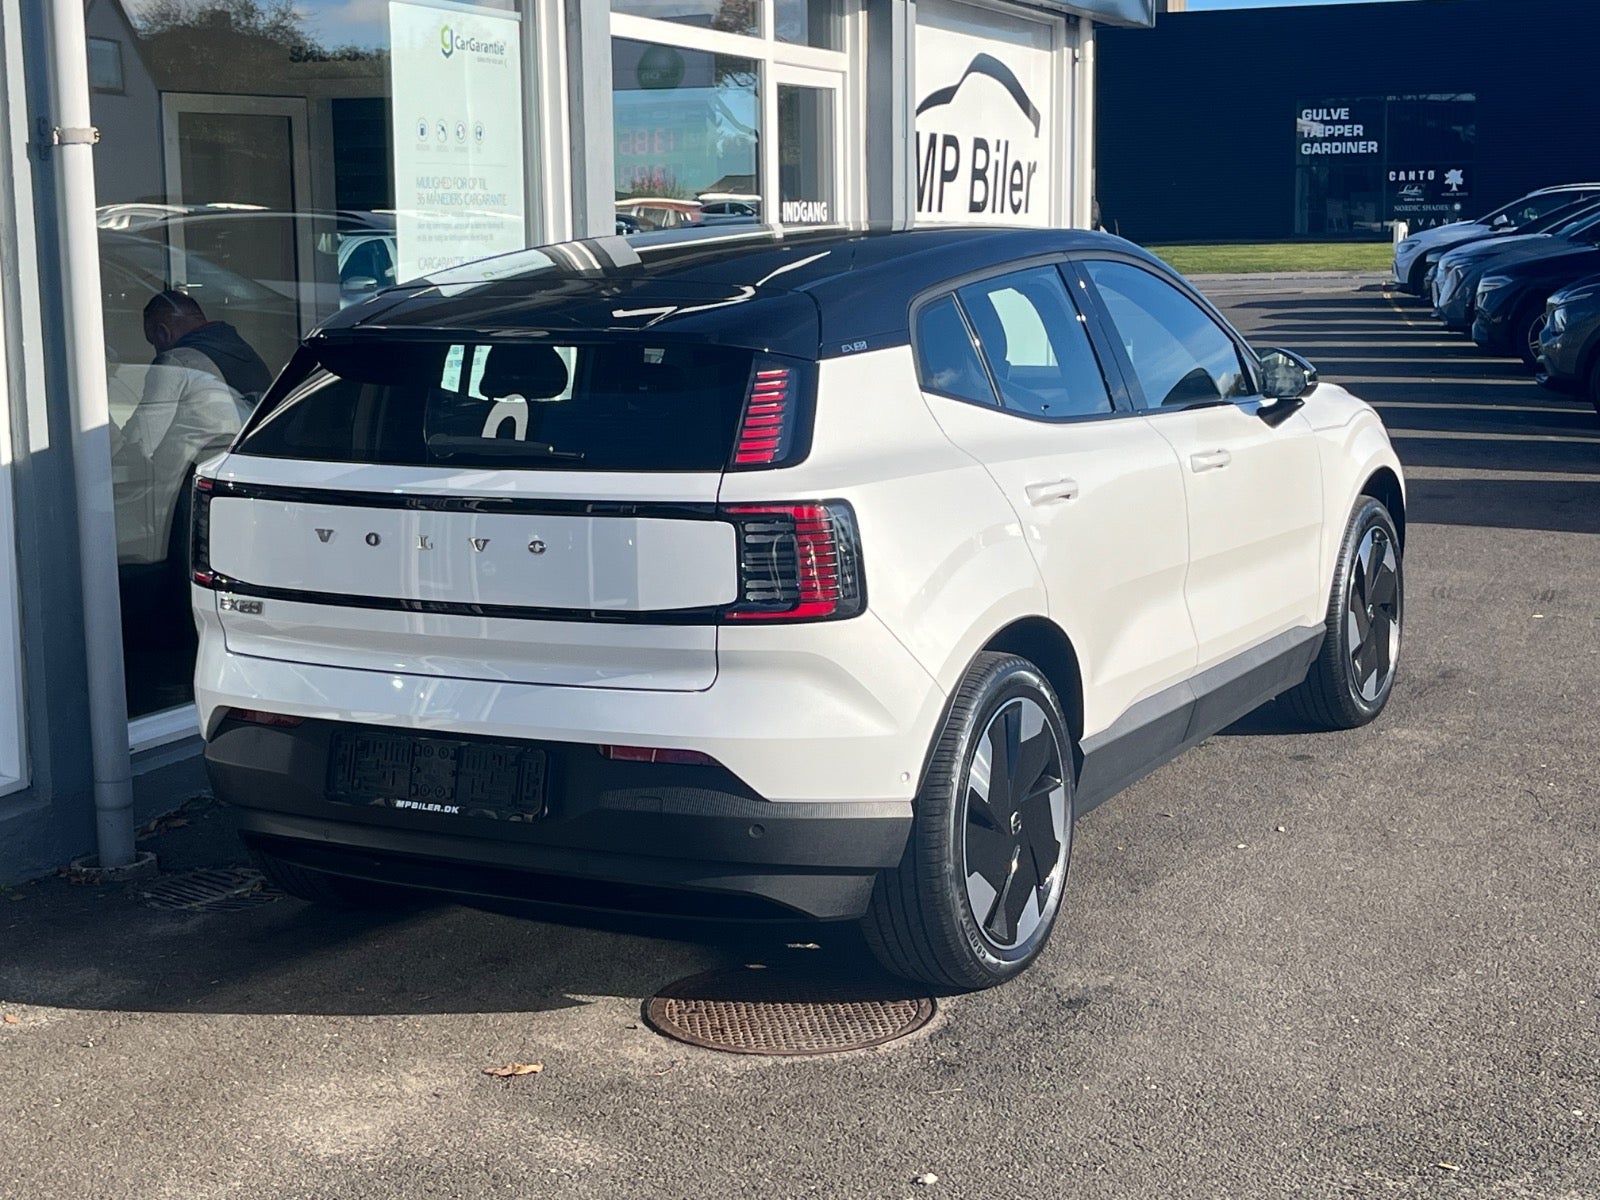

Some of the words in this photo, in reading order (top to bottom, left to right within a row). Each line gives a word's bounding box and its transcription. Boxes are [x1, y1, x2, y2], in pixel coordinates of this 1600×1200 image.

[454, 35, 505, 56] CarGarantie
[1302, 108, 1350, 120] GULVE
[1302, 124, 1364, 138] TÆPPER
[1301, 141, 1378, 155] GARDINER
[916, 131, 960, 213] MP
[968, 136, 1037, 215] Biler
[1388, 170, 1435, 181] CANTO
[782, 201, 828, 223] INDGANG
[315, 528, 547, 554] VOLVO
[395, 799, 460, 815] MPBILER.DK
